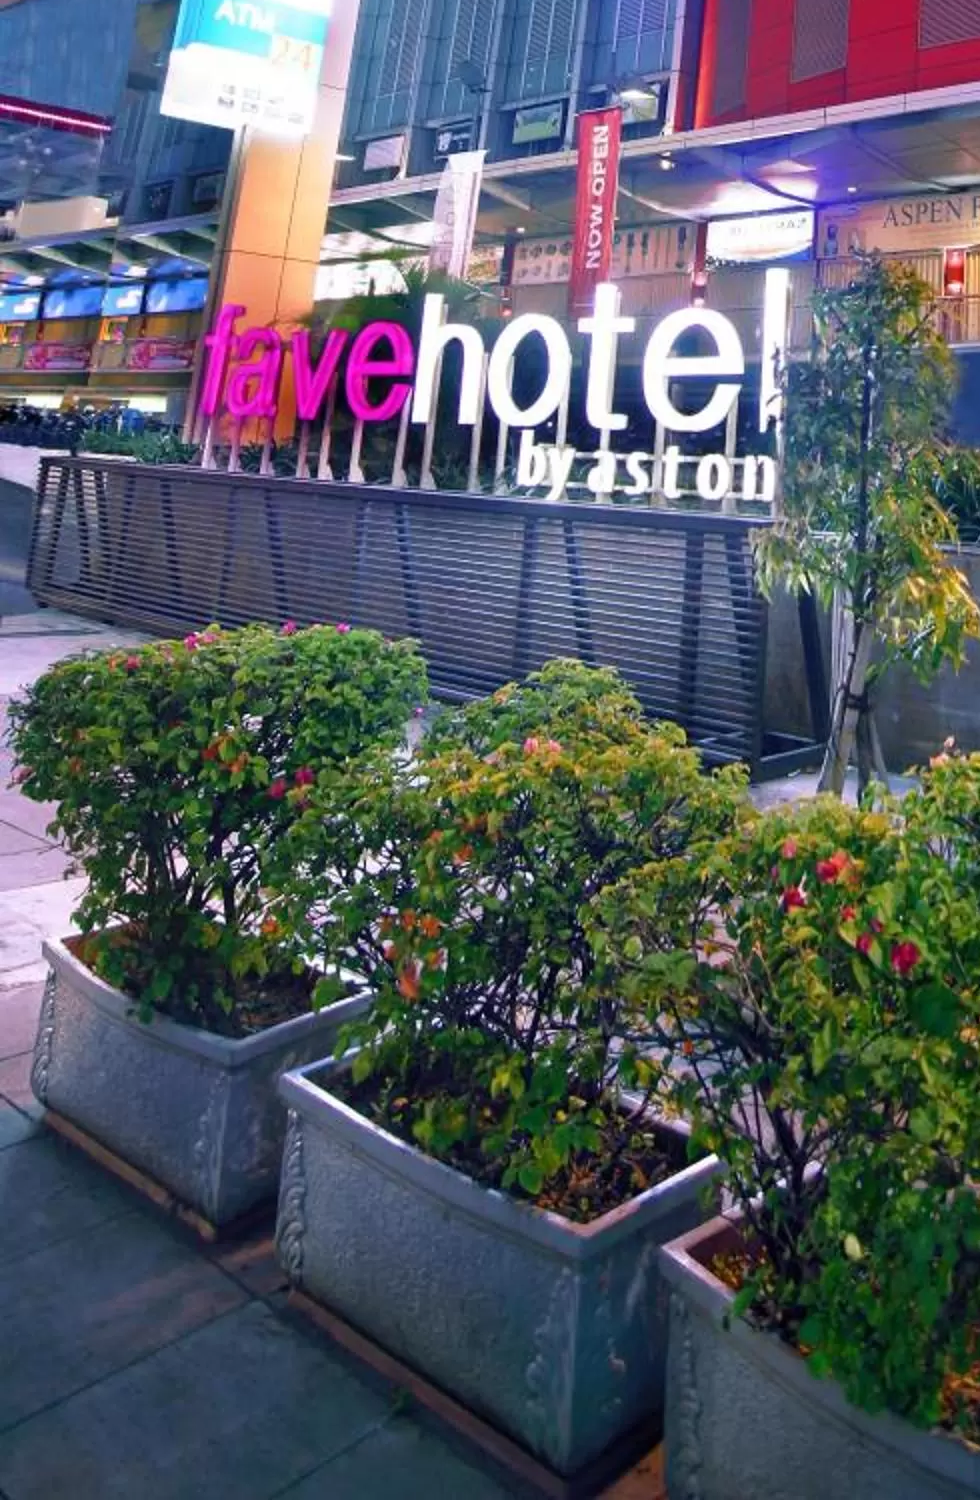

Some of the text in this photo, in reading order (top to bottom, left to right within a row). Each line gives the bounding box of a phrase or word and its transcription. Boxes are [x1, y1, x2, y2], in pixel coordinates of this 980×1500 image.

[585, 125, 609, 269] NOW OPEN
[882, 197, 963, 229] ASPEN
[516, 429, 778, 503] by aston
